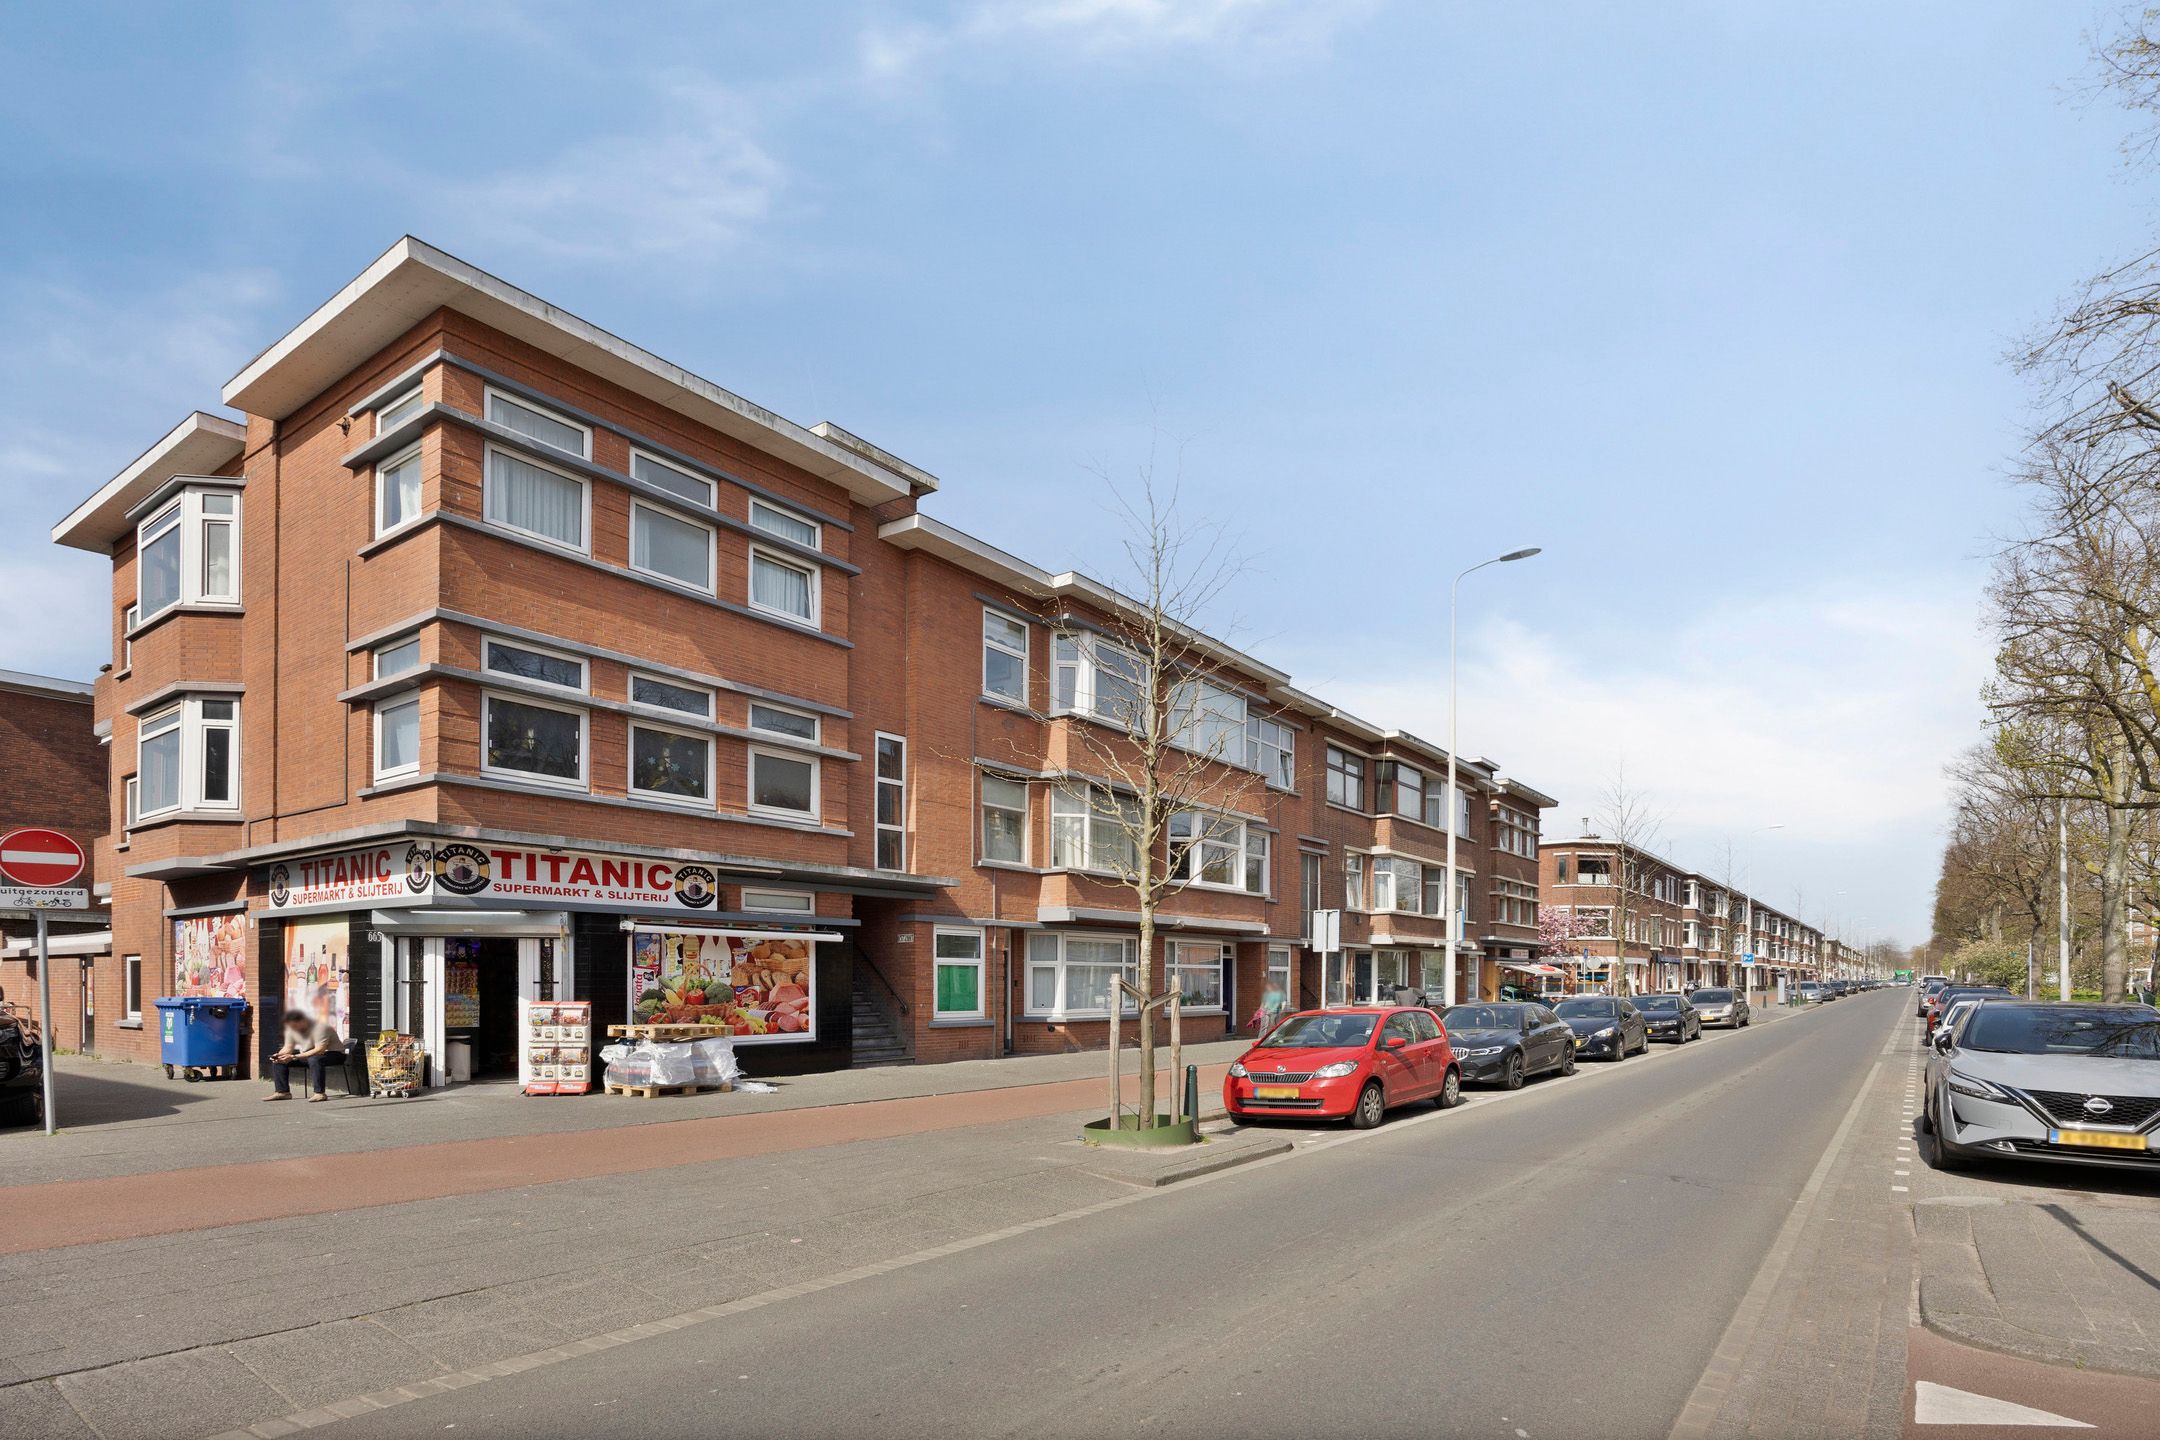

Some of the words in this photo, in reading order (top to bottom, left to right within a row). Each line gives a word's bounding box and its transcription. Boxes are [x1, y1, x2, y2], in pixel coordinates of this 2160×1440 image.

[440, 847, 485, 862] TITANIC
[300, 850, 392, 891] TITANIC
[491, 850, 673, 891] TITANIC
[678, 868, 712, 882] TITANIC
[0, 888, 83, 896] uitgezonderd
[292, 888, 346, 905] SUPERMARKT
[348, 887, 354, 899] &
[357, 882, 403, 898] SLIJTERIJ
[493, 883, 590, 898] SUPERMARKT
[594, 889, 604, 899] &
[608, 890, 669, 903] SLIJTERIJ
